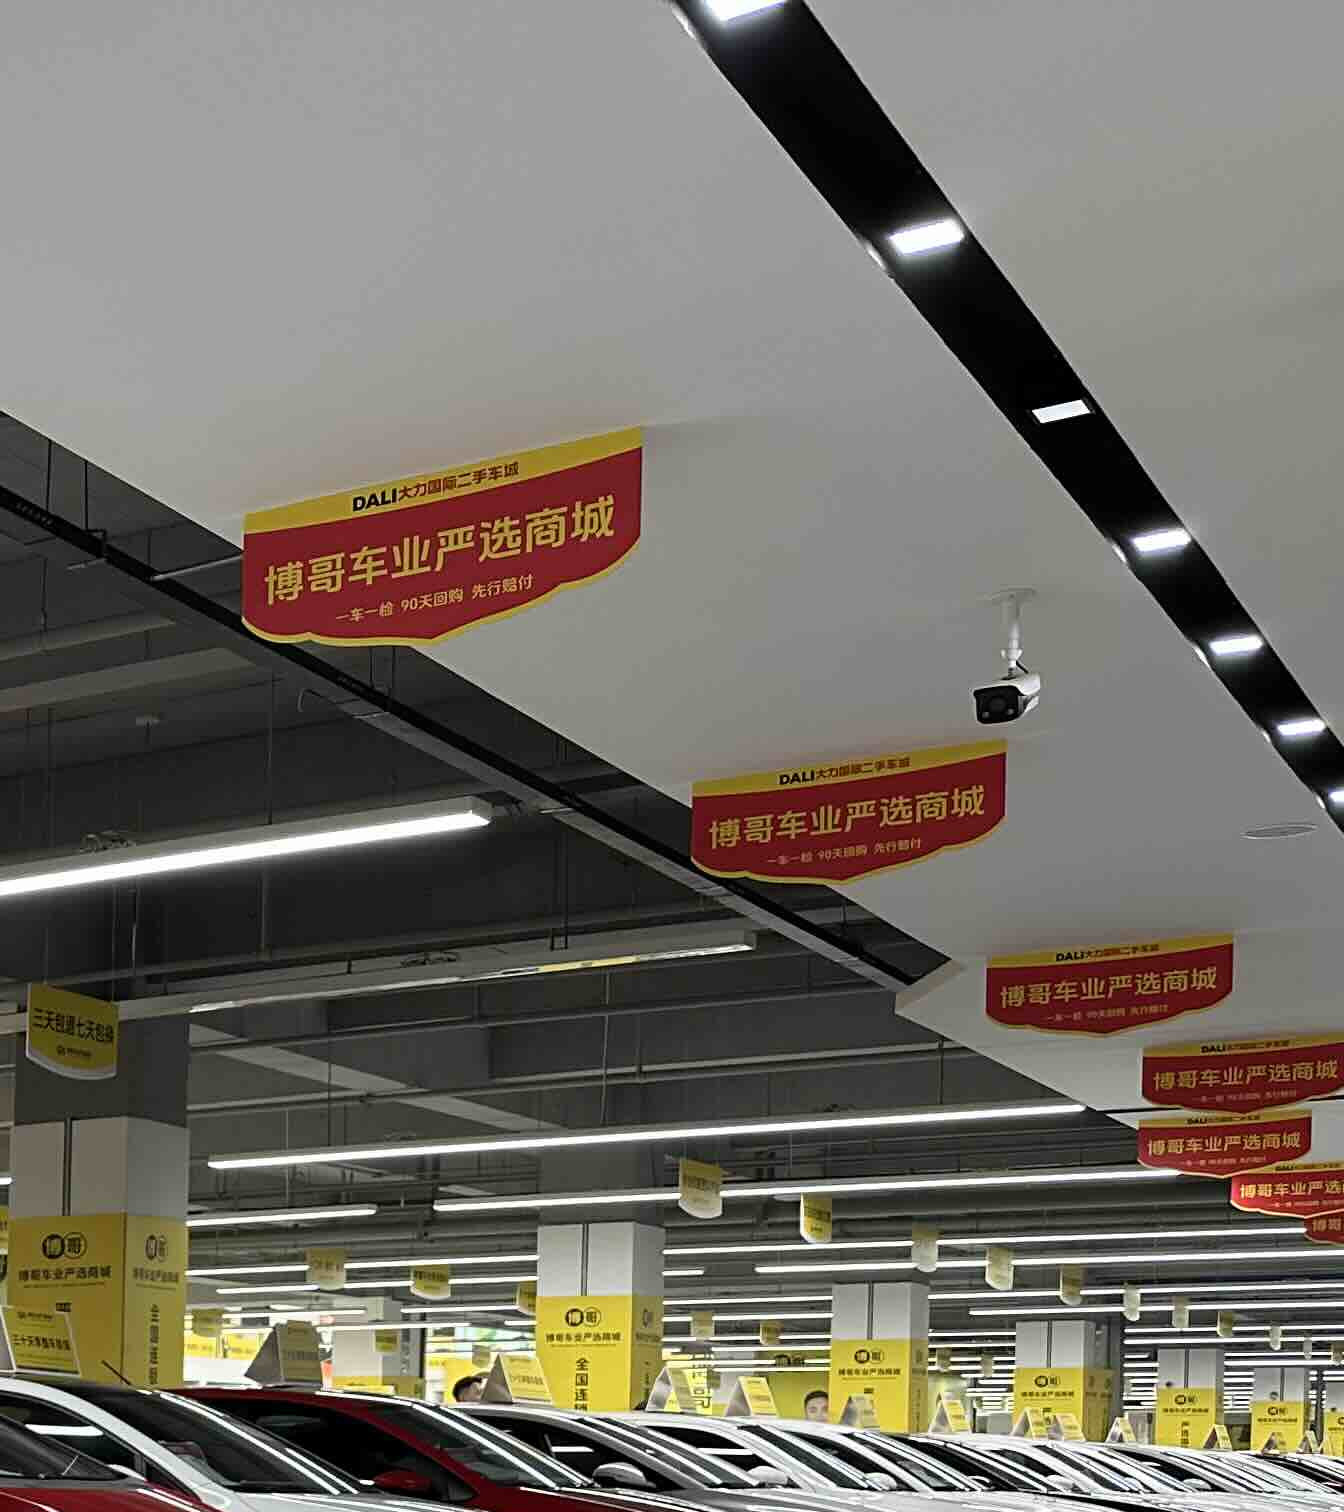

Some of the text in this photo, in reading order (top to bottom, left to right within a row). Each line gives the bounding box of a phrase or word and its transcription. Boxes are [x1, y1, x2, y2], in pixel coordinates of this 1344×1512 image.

[264, 495, 615, 605] 博哥车业严选商城
[401, 588, 463, 612] 90天回购
[709, 785, 985, 849] 博哥车业严选商城
[1000, 967, 1218, 1008] 博哥车业严选商城
[1153, 1060, 1338, 1091] 博哥车业严选商城
[1148, 1132, 1301, 1156] 博哥车业严选商城
[1240, 1180, 1344, 1199] 博哥车业严选
